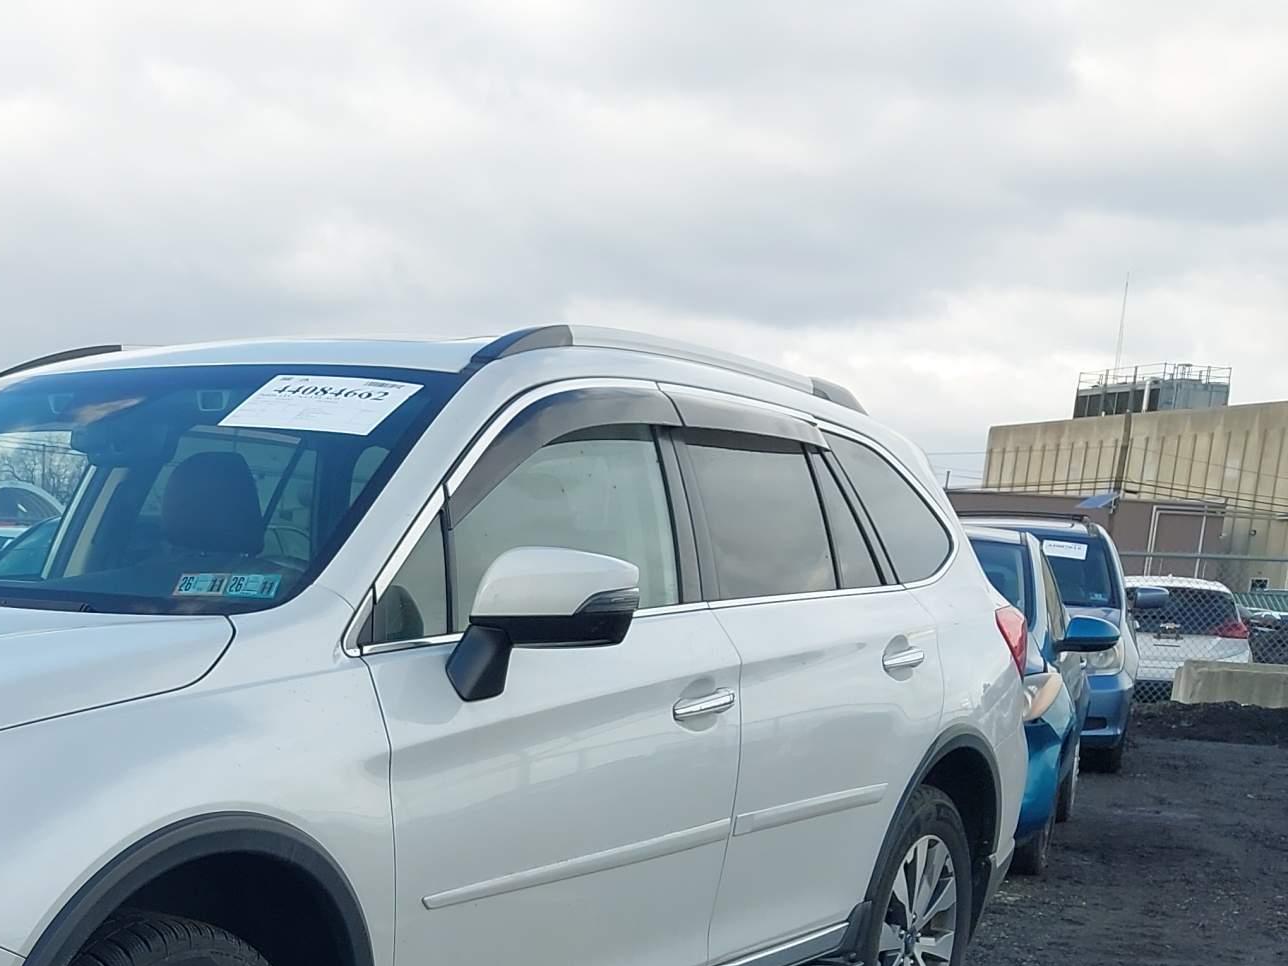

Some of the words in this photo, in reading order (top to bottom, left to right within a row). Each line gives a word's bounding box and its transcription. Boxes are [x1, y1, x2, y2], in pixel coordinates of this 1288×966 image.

[178, 577, 194, 592] 26
[208, 578, 225, 593] 11
[229, 577, 245, 592] 26
[260, 581, 275, 594] 11
